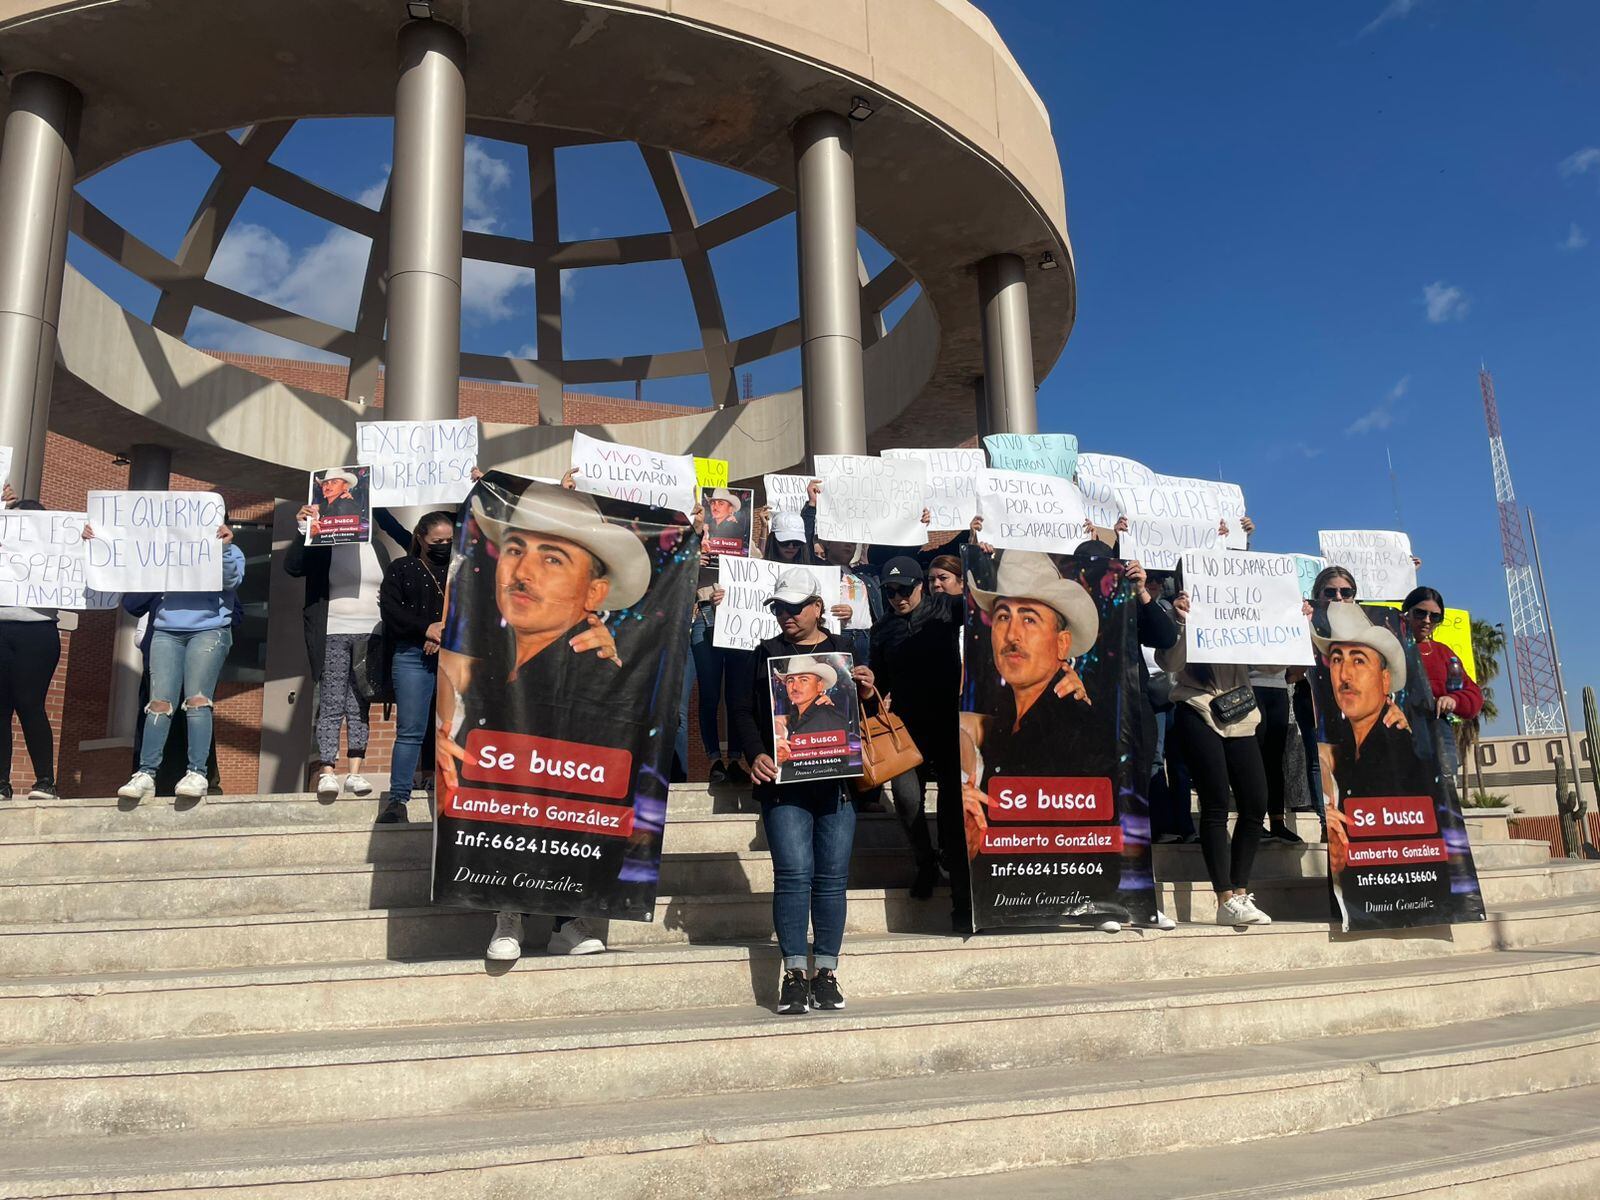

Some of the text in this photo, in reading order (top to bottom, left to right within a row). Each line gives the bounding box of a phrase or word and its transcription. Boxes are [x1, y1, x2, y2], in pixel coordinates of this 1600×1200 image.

[986, 435, 1022, 450] VIVO
[1028, 435, 1052, 451] SE
[597, 448, 665, 471] VIVO SE
[585, 462, 602, 480] LO
[609, 465, 677, 487] LLEVARON
[989, 477, 1054, 497] JUSTICIA
[89, 495, 127, 528] TE
[1005, 497, 1064, 515] POR LOS
[1114, 487, 1147, 515] TE
[1170, 523, 1216, 550] VIVO
[89, 536, 211, 568] DE VUELTA
[725, 558, 759, 583] VIVO
[1185, 553, 1200, 575] EL
[1202, 555, 1219, 577] NO
[1191, 583, 1262, 605] A EL SE LO
[723, 613, 743, 636] LO
[794, 735, 838, 746] Se busca
[477, 745, 606, 784] Se busca
[999, 788, 1097, 810] Se busca
[452, 795, 621, 829] Lamberto González
[1353, 806, 1425, 827] Se busca
[454, 829, 602, 860] Inf:6624156604
[985, 831, 1113, 848] Lamberto González
[1348, 843, 1441, 861] Lamberto González
[453, 865, 584, 894] Dunia González
[991, 862, 1104, 877] Inf:6624156604
[1356, 870, 1438, 887] Inf:6624156604
[993, 890, 1091, 907] Dunia González
[1365, 896, 1435, 913] Dunia González
